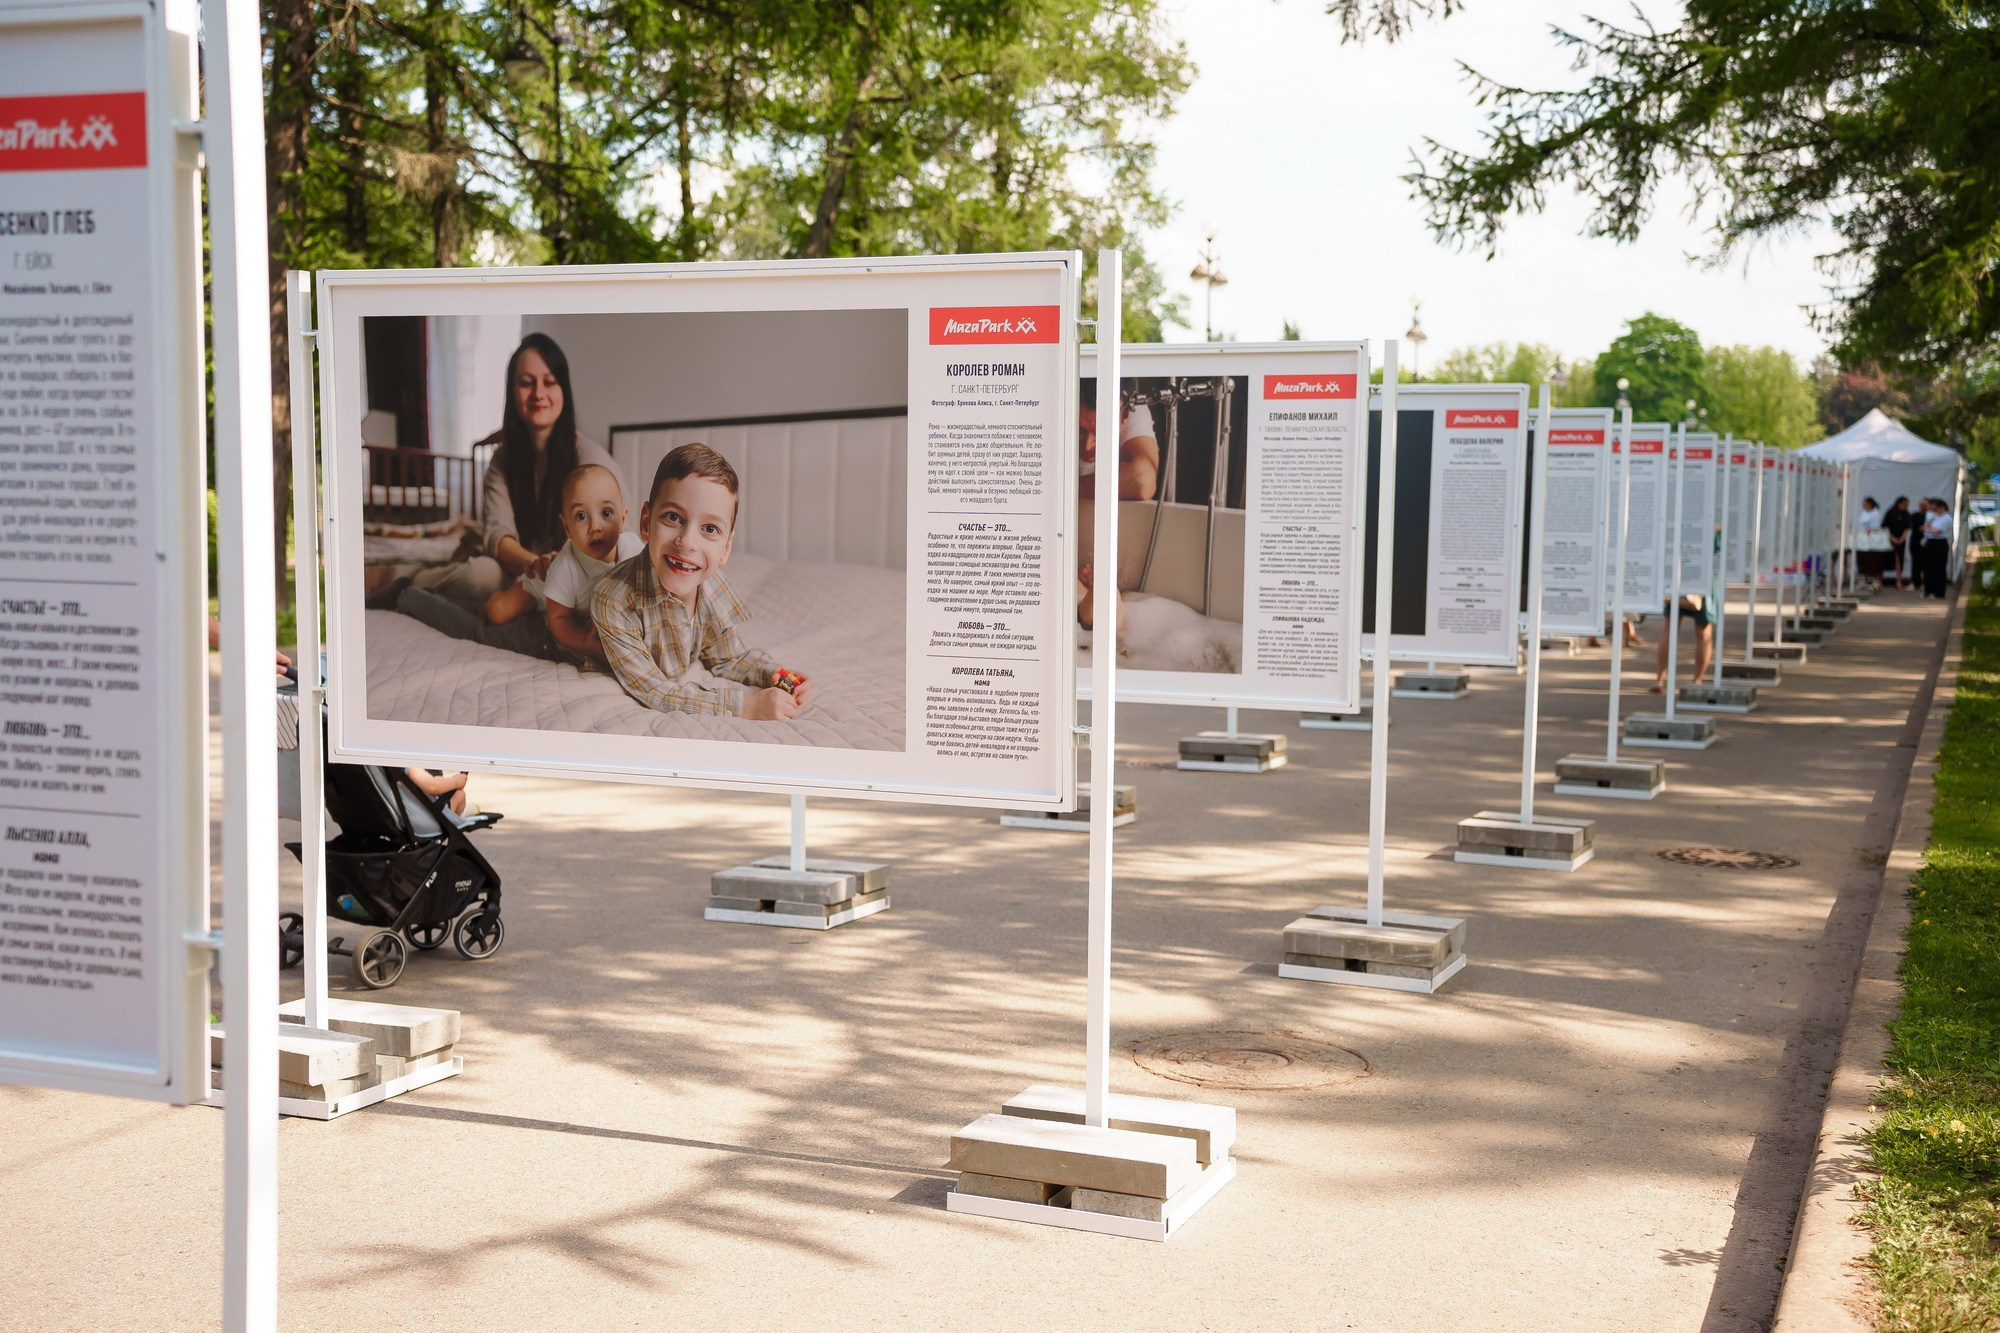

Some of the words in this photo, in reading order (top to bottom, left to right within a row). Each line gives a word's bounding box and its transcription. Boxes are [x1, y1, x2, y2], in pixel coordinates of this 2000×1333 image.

[54, 210, 96, 235] ГЛЕБ
[944, 318, 1014, 336] MazaPark
[947, 364, 989, 376] КОРОЛЕВ
[992, 364, 1024, 376] РОМАН
[951, 385, 956, 393] Г.
[958, 384, 1019, 393] САНКТ-ПЕТЕРБУРГ
[1274, 382, 1324, 394] MazaPark
[932, 399, 956, 407] Фотограф:
[977, 399, 994, 407] Алиса,
[999, 399, 1039, 407] Санкт-Петербург
[1269, 412, 1307, 421] ЕПИФАНОВ
[1308, 412, 1338, 420] МИХАИЛ
[959, 523, 986, 532] СЧАСТЬЕ
[994, 524, 1011, 532] ЭТО...
[958, 621, 984, 631] ЛЮБОВЬ
[993, 622, 1010, 632] ЭТО...
[952, 666, 984, 677] КОРОЛЕВА
[986, 668, 1015, 679] ТАТЬЯНА,
